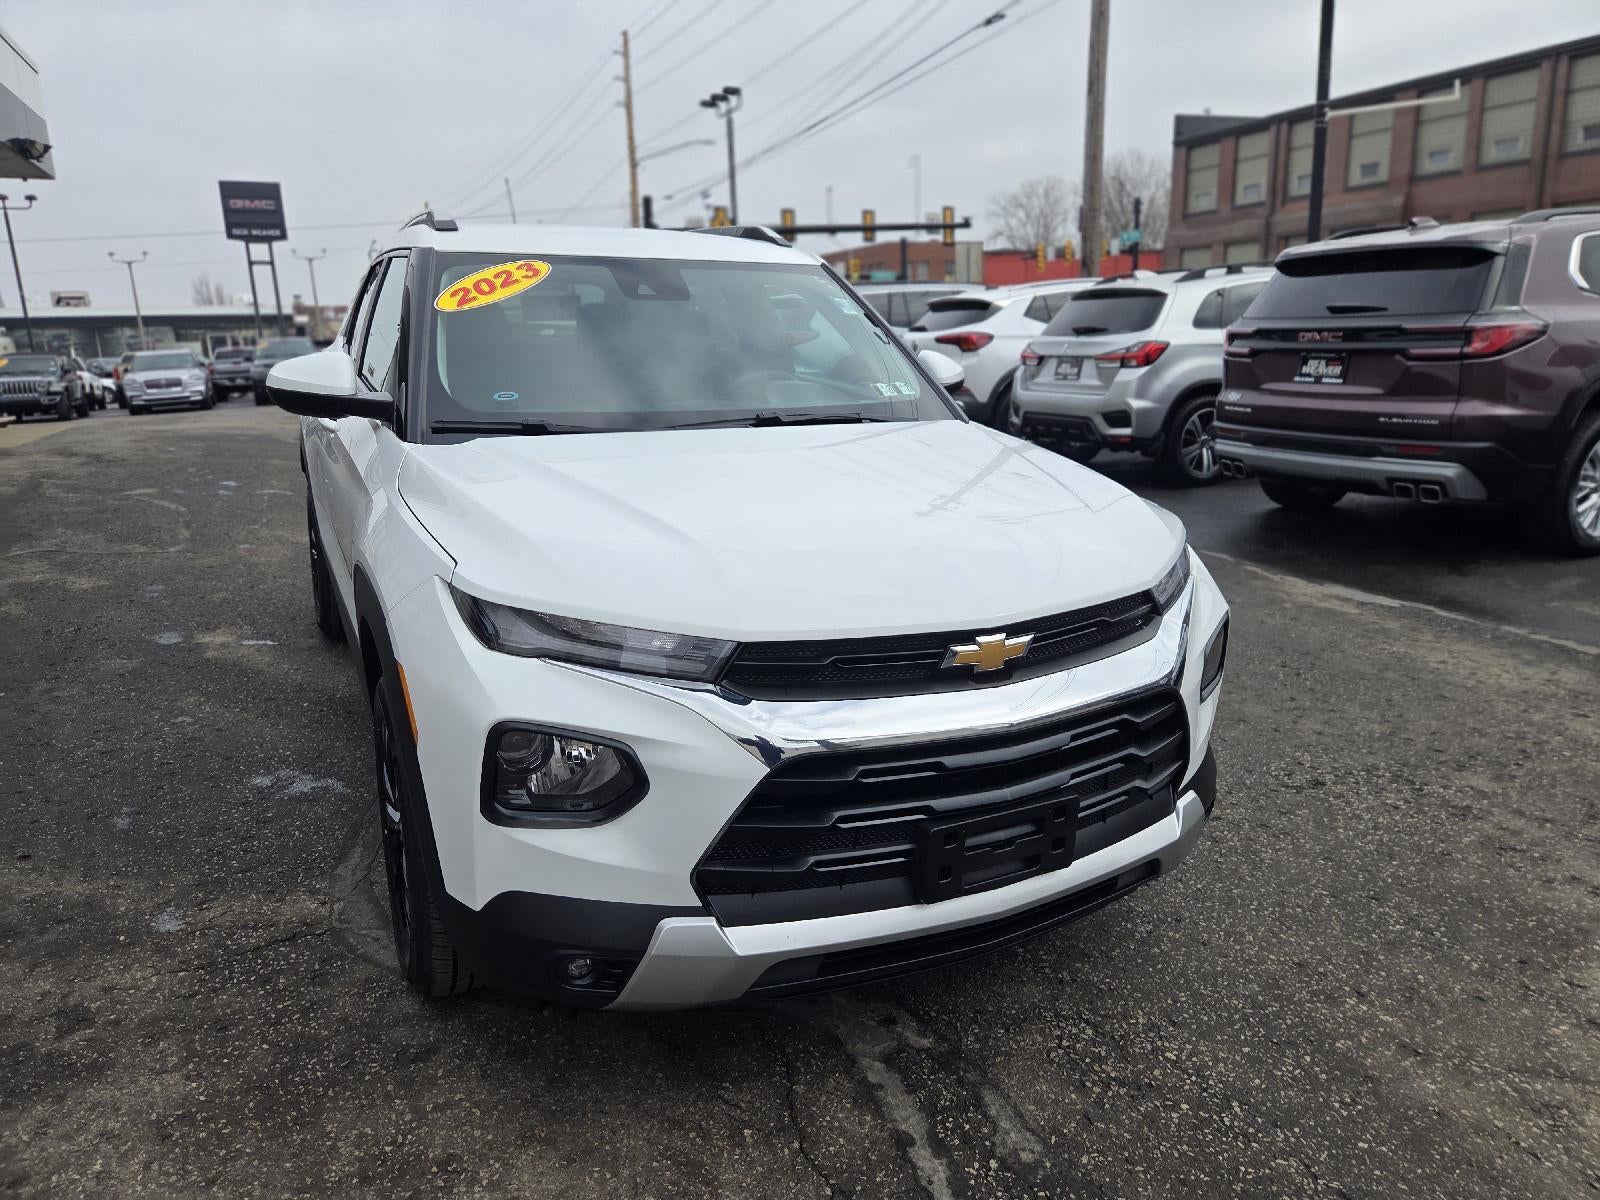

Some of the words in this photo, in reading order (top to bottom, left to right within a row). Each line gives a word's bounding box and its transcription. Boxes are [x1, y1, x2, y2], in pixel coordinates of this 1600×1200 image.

[229, 199, 276, 210] GMC
[449, 262, 541, 308] 2023
[1297, 331, 1343, 342] GMC
